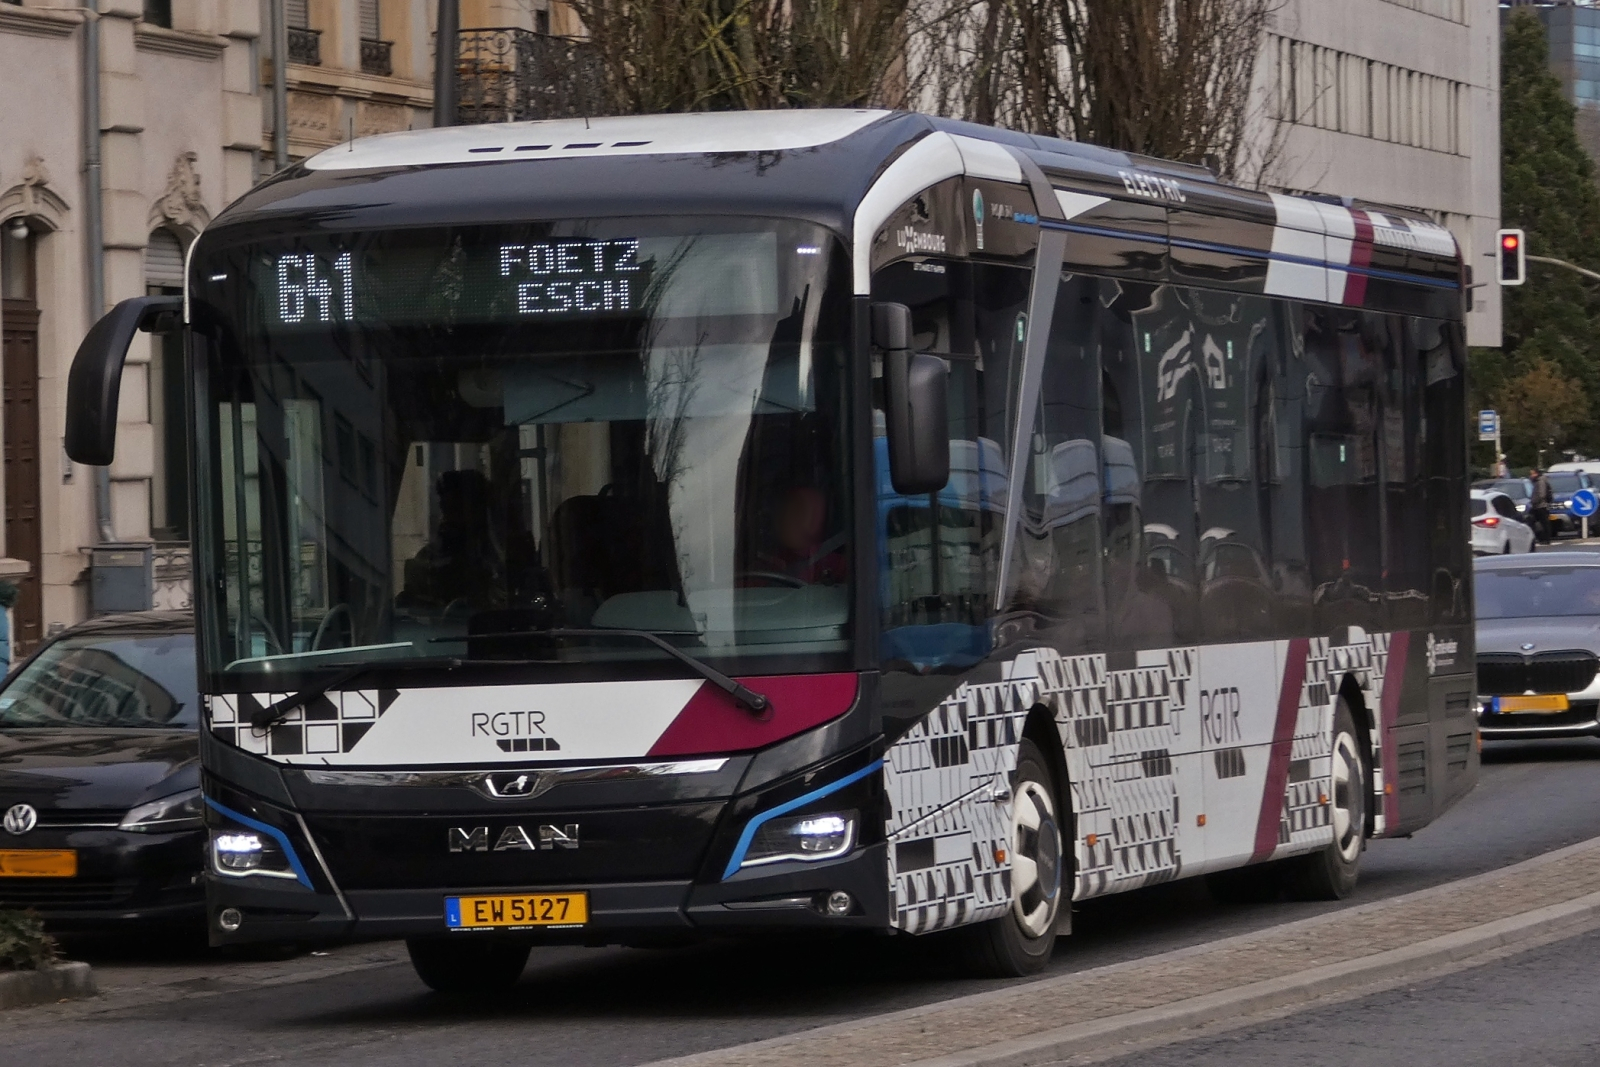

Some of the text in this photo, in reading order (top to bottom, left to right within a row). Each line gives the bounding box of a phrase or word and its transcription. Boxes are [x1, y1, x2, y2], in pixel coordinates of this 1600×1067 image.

[1118, 171, 1187, 202] ELECTRIC
[897, 226, 946, 253] LUXEMBOURG
[500, 240, 640, 276] FOETZ
[277, 253, 353, 322] 641
[518, 279, 630, 314] ESCH
[471, 710, 547, 737] RGTR
[1200, 687, 1241, 747] RGTR
[448, 823, 580, 853] MAN
[450, 913, 458, 922] L
[474, 898, 570, 922] EW 5127
